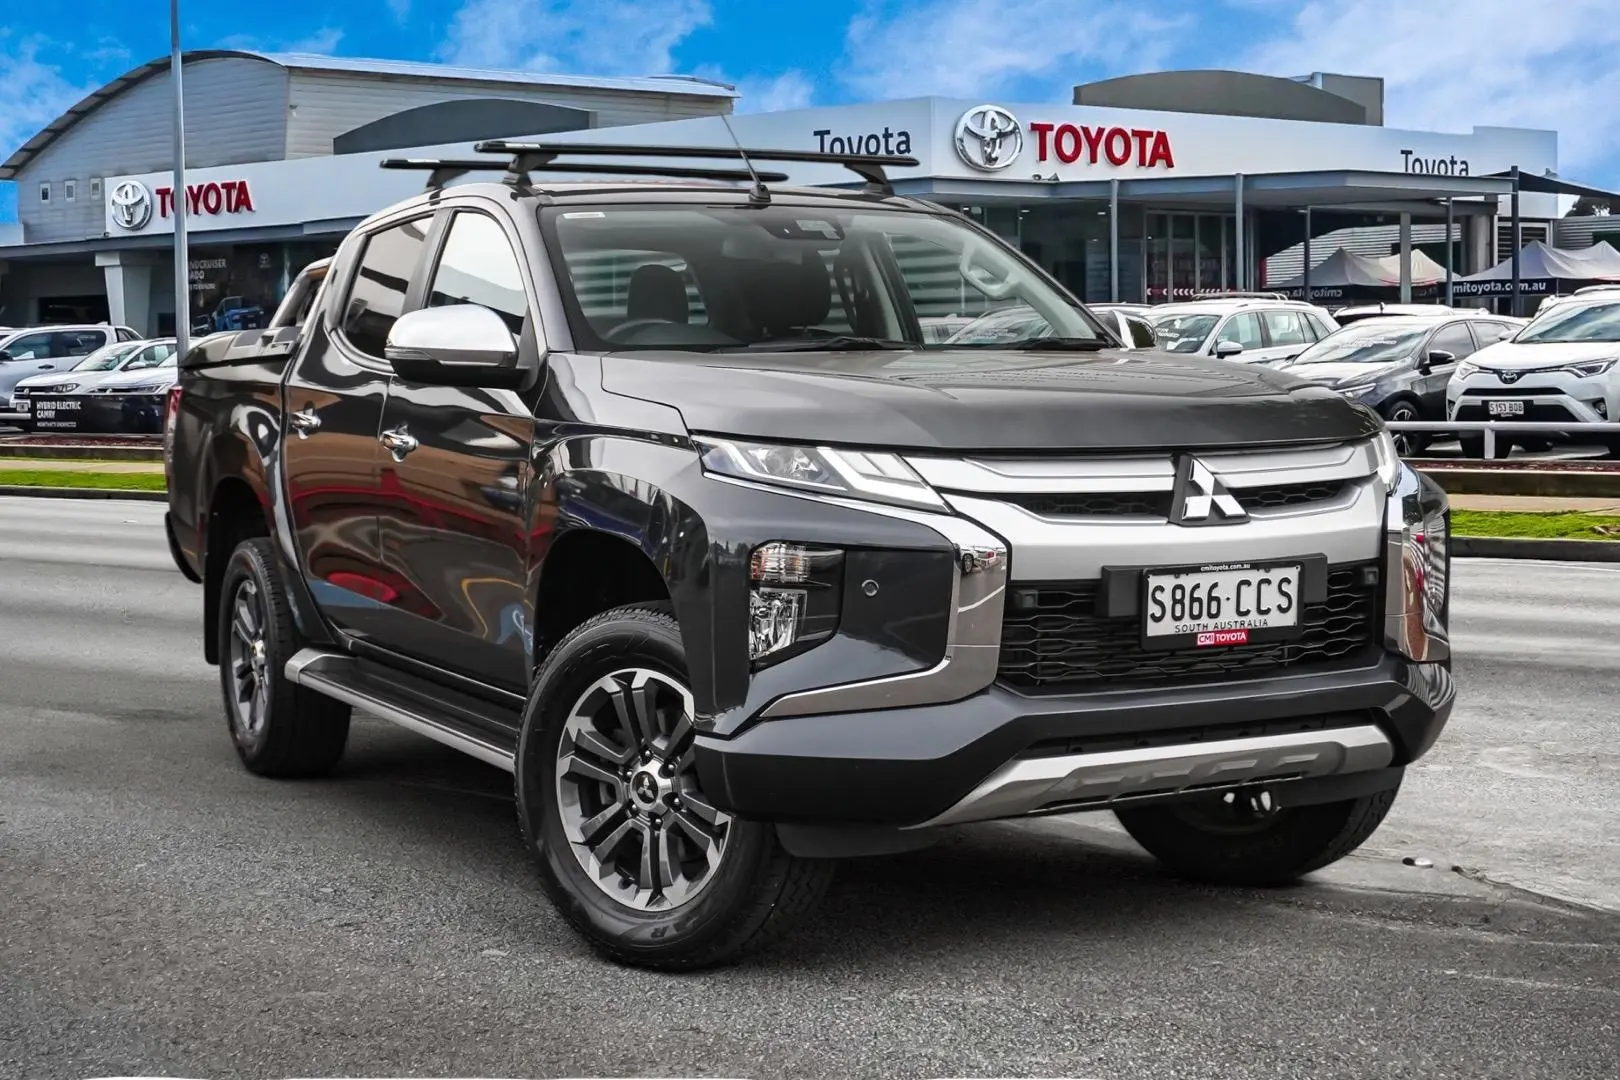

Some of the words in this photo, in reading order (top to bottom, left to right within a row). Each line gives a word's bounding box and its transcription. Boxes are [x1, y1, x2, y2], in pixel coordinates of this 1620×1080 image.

[813, 127, 912, 155] Toyota
[1030, 122, 1174, 169] TOYOTA
[1400, 149, 1469, 176] Toyota
[1200, 563, 1251, 573] cmitoyota.com.au
[1175, 623, 1209, 634] SOUTH
[1212, 618, 1269, 630] AUSTRALIA
[1215, 631, 1247, 643] TOYOTA
